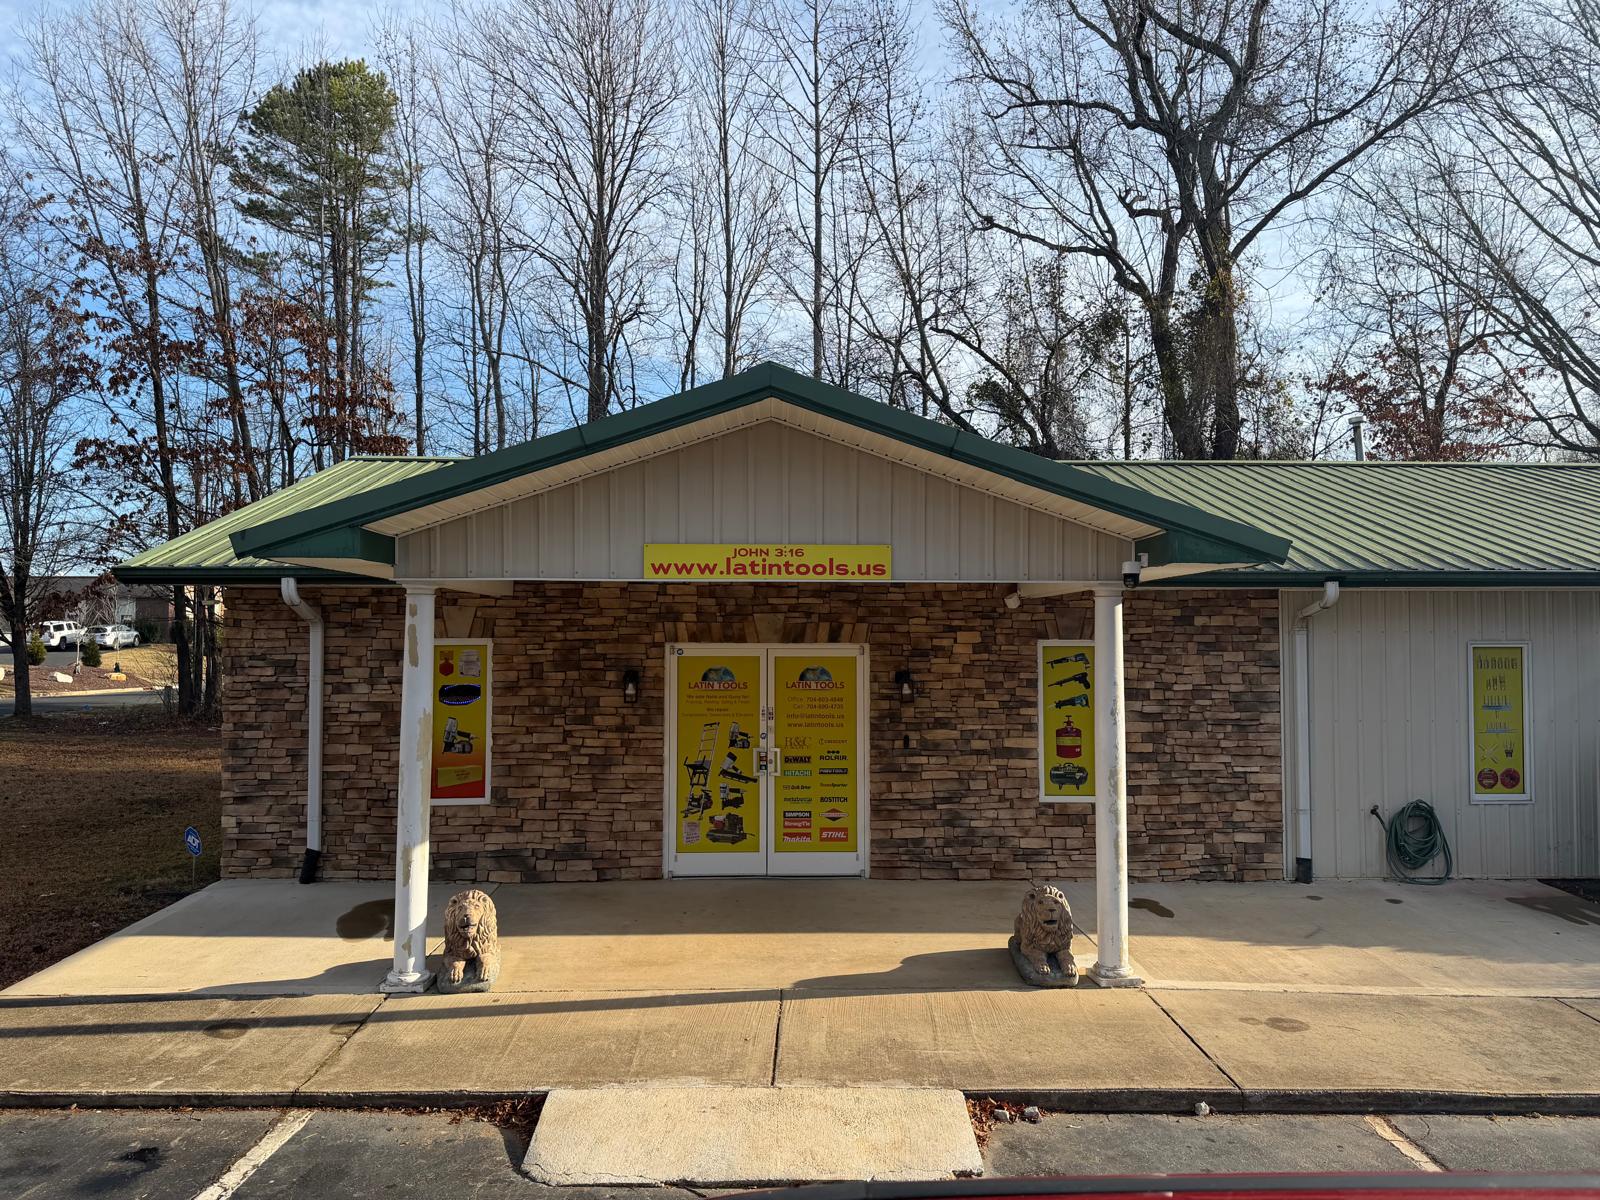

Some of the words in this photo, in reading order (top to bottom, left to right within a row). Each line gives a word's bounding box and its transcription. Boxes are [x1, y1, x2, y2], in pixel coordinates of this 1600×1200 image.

[732, 547, 770, 559] JOHN
[775, 547, 805, 558] 3:16
[650, 557, 887, 577] www.latintools.us
[688, 681, 714, 689] LATIN
[718, 681, 748, 689] TOOLS
[786, 681, 811, 689] LATIN
[813, 681, 845, 689] TOOLS
